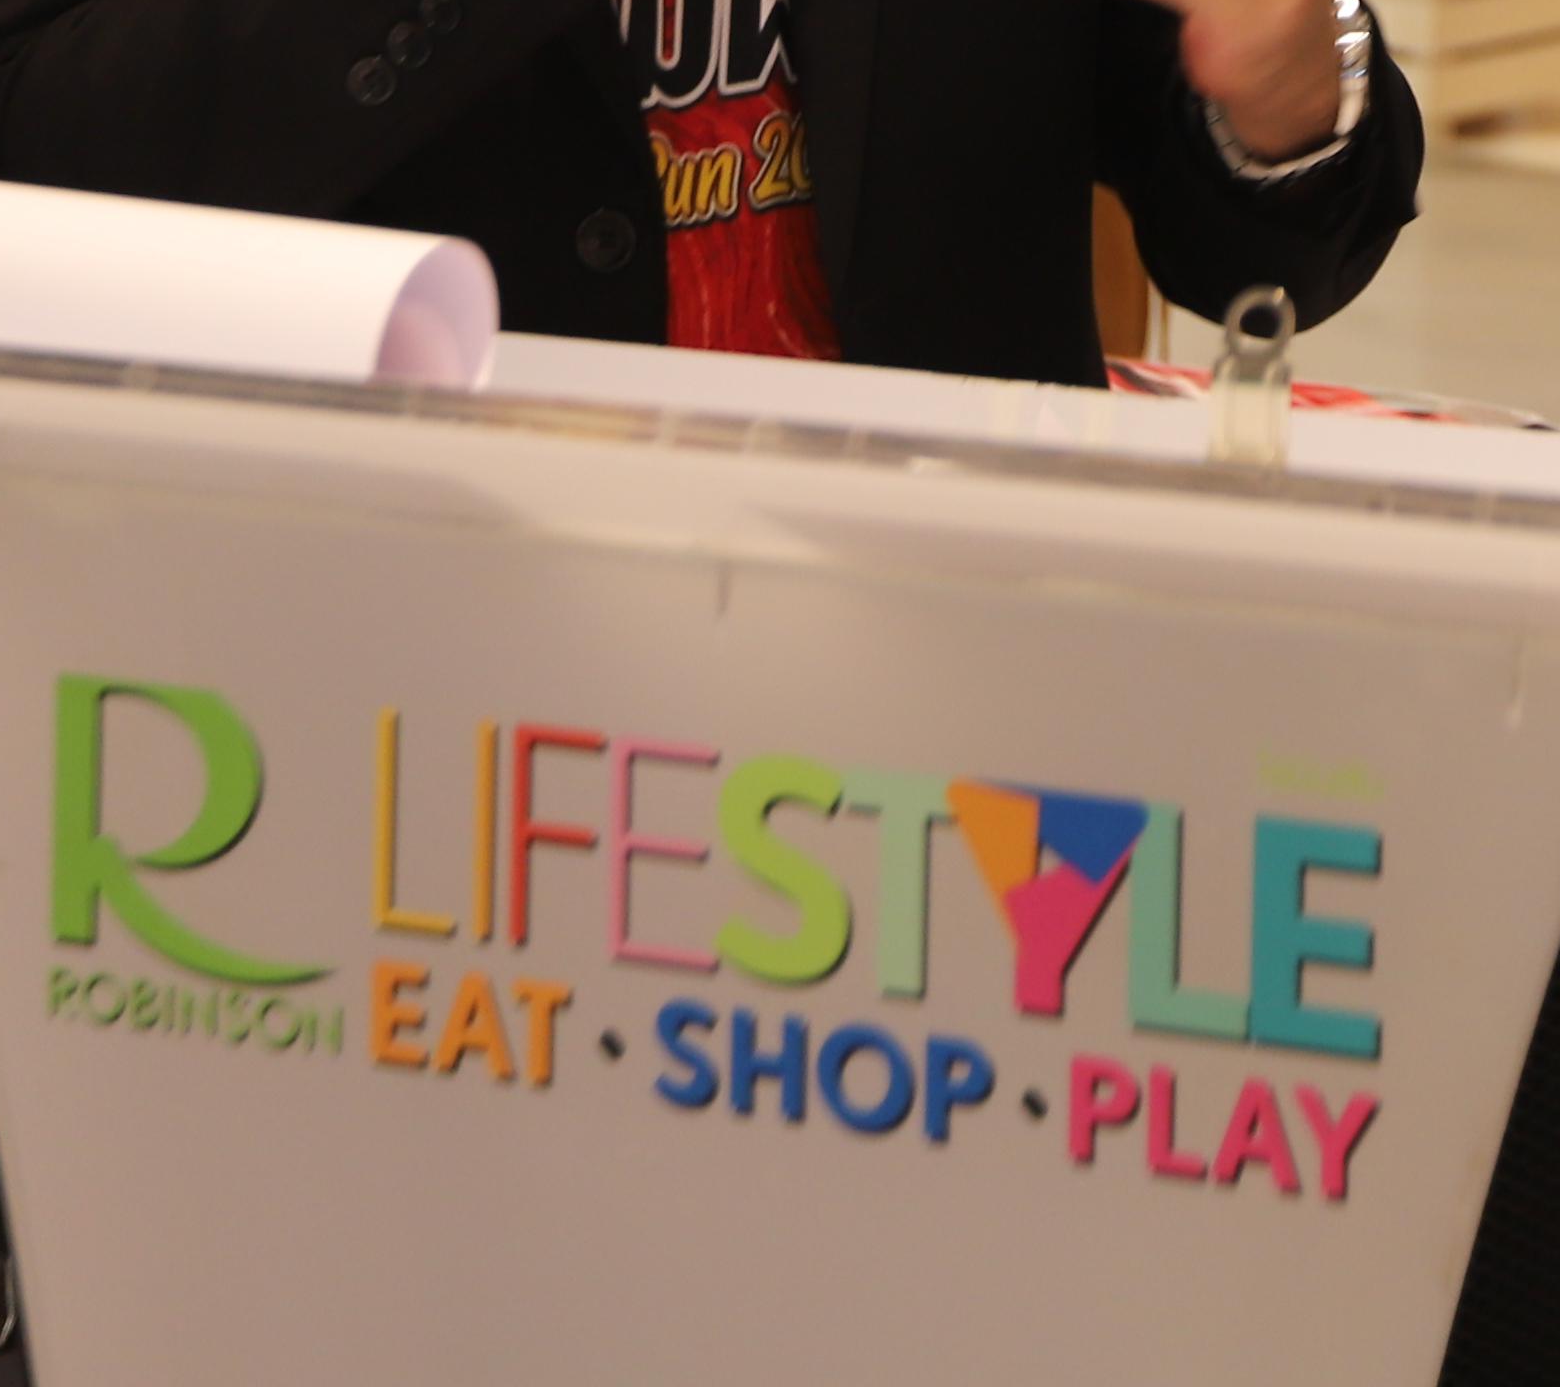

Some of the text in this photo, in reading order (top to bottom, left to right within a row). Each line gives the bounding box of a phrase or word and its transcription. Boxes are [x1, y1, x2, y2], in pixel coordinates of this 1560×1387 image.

[371, 703, 1383, 1063] LIFESTYLE
[47, 965, 346, 1059] ROBINSON
[368, 957, 1380, 1203] EAT SHOP PLAY
